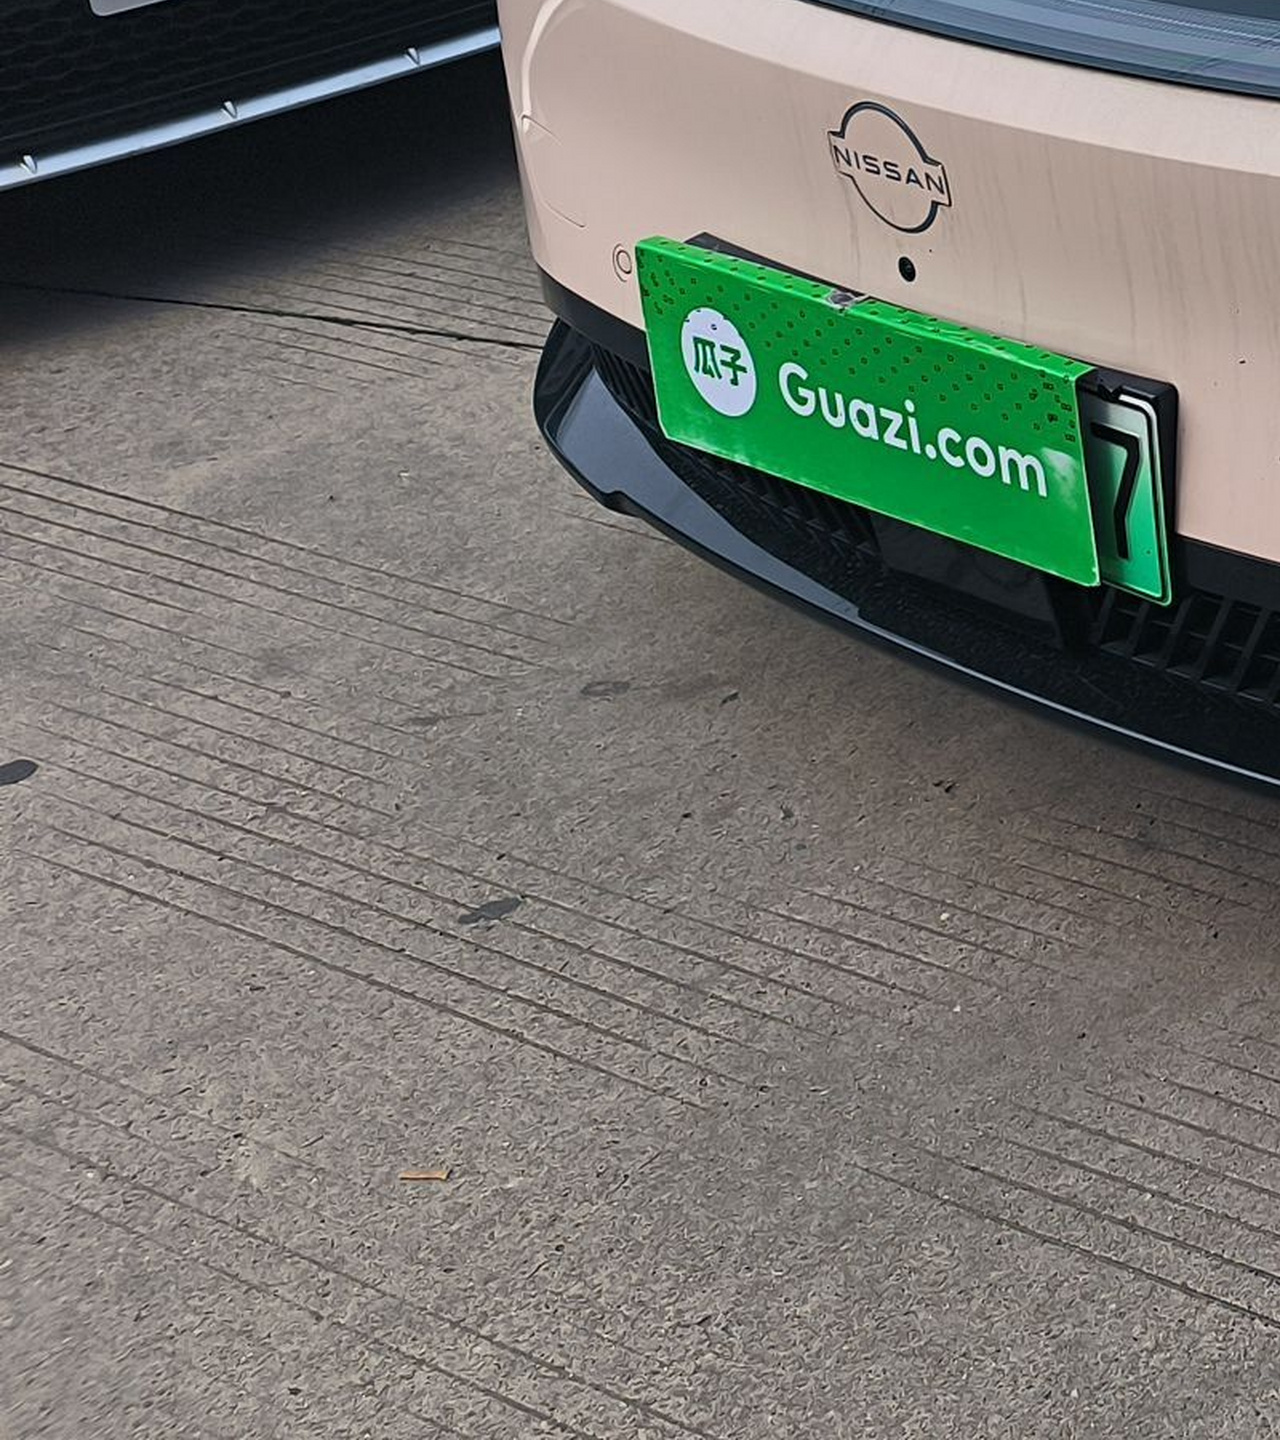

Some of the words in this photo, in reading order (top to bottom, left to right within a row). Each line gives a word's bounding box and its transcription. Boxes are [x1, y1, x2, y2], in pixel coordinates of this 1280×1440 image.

[833, 145, 945, 195] NISSAN
[692, 337, 748, 387] 瓜子
[778, 361, 1048, 498] Guazi.com
